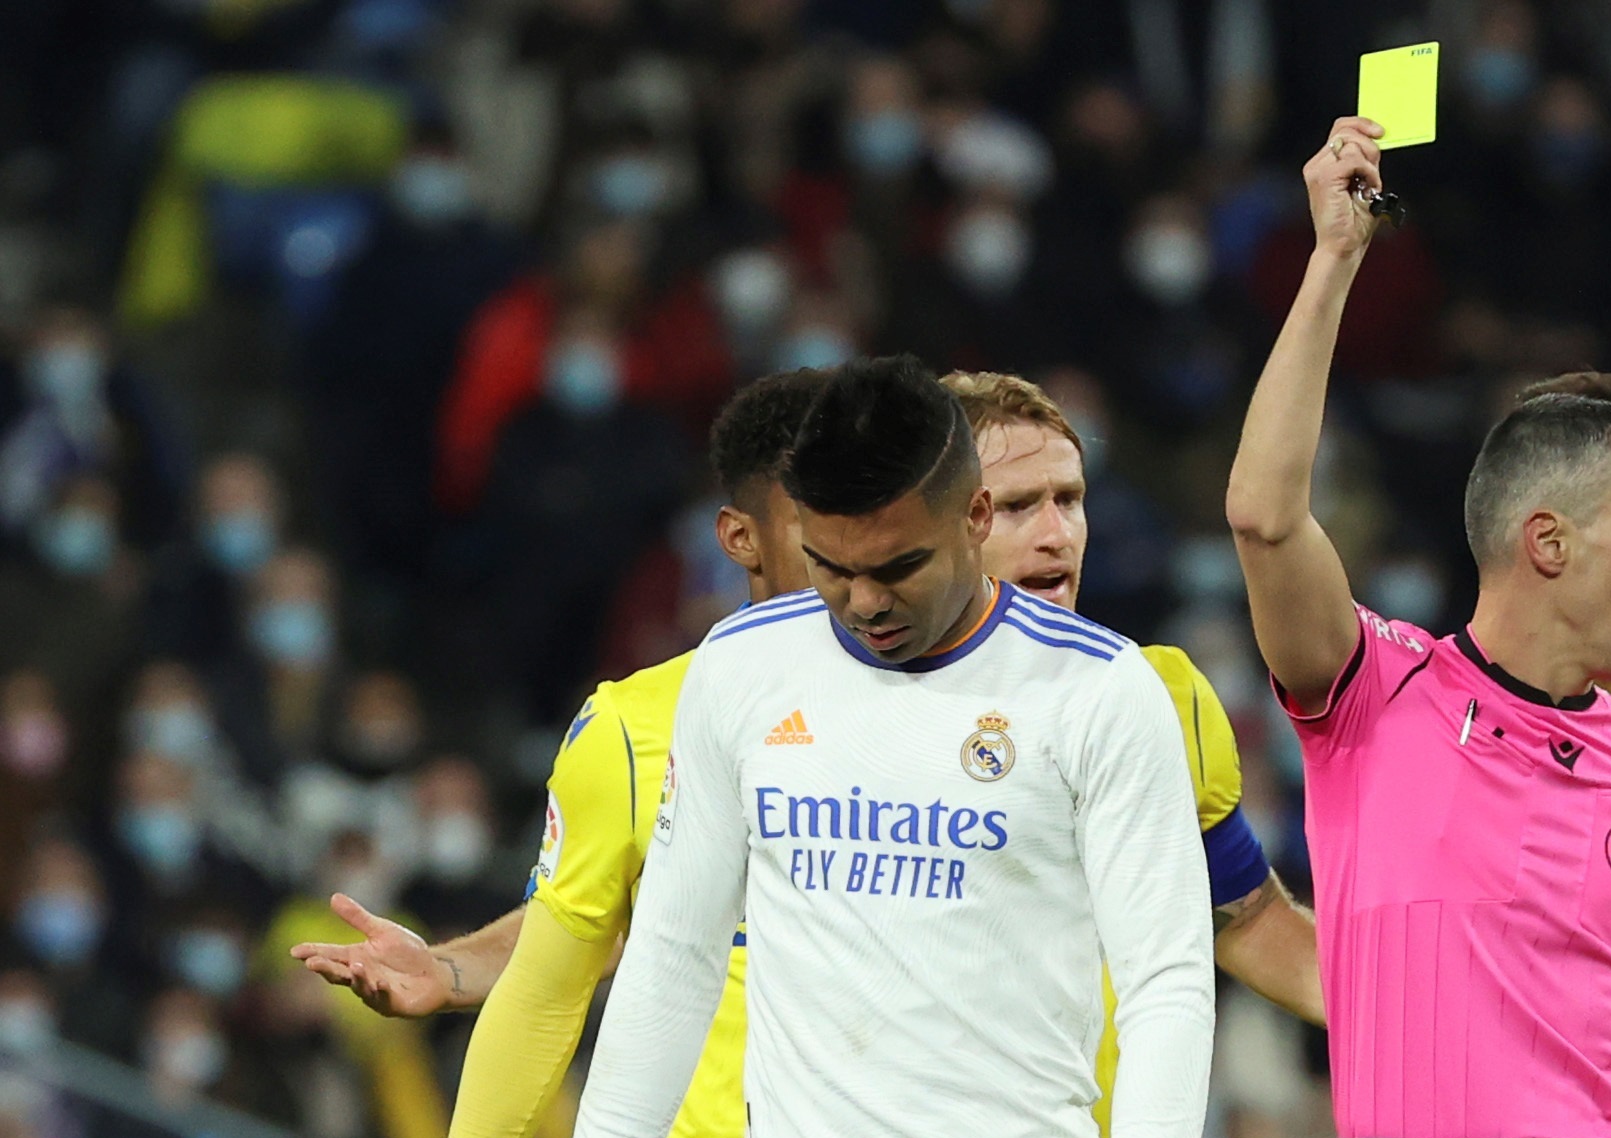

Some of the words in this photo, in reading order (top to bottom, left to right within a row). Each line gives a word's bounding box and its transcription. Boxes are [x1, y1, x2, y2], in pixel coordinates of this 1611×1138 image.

[1411, 47, 1432, 57] FIFA
[764, 731, 814, 746] adidas
[756, 785, 1009, 851] Emirates
[791, 848, 835, 890] FLY
[846, 852, 966, 900] BETTER
